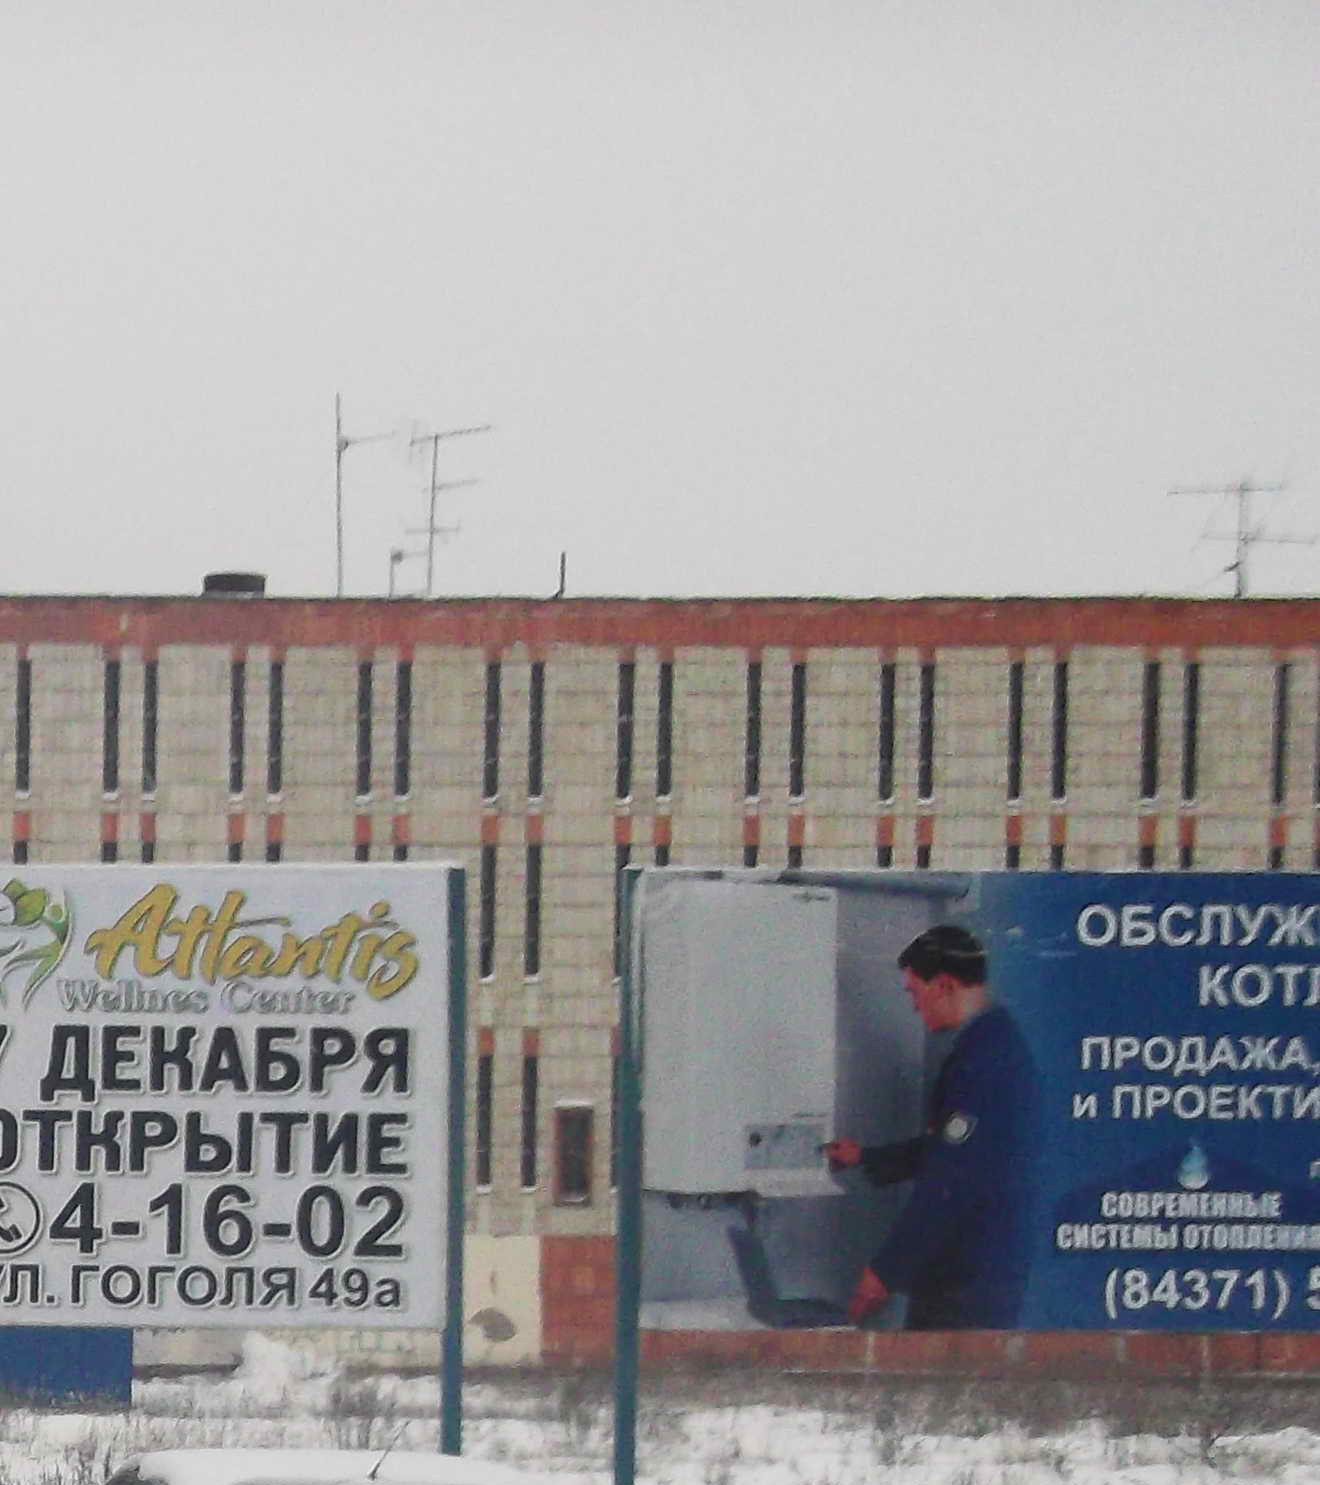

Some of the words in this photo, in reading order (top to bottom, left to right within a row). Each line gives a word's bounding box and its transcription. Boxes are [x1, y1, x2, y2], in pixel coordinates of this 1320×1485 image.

[83, 882, 419, 1001] Atlantis
[1076, 903, 1320, 947] ОБСЛУЖ
[220, 980, 356, 1014] Center
[39, 1023, 410, 1102] ДЕКАБРЯ
[1072, 1091, 1099, 1120] и
[1112, 1084, 1320, 1121] ПРОЕКТИ
[48, 1182, 405, 1258] 4-16-02
[1056, 1222, 1180, 1249] СИСТЕМЫ
[70, 1264, 297, 1306] ГОГОЛЯ
[308, 1267, 402, 1308] 49а
[1105, 1267, 1290, 1320] (84371)
